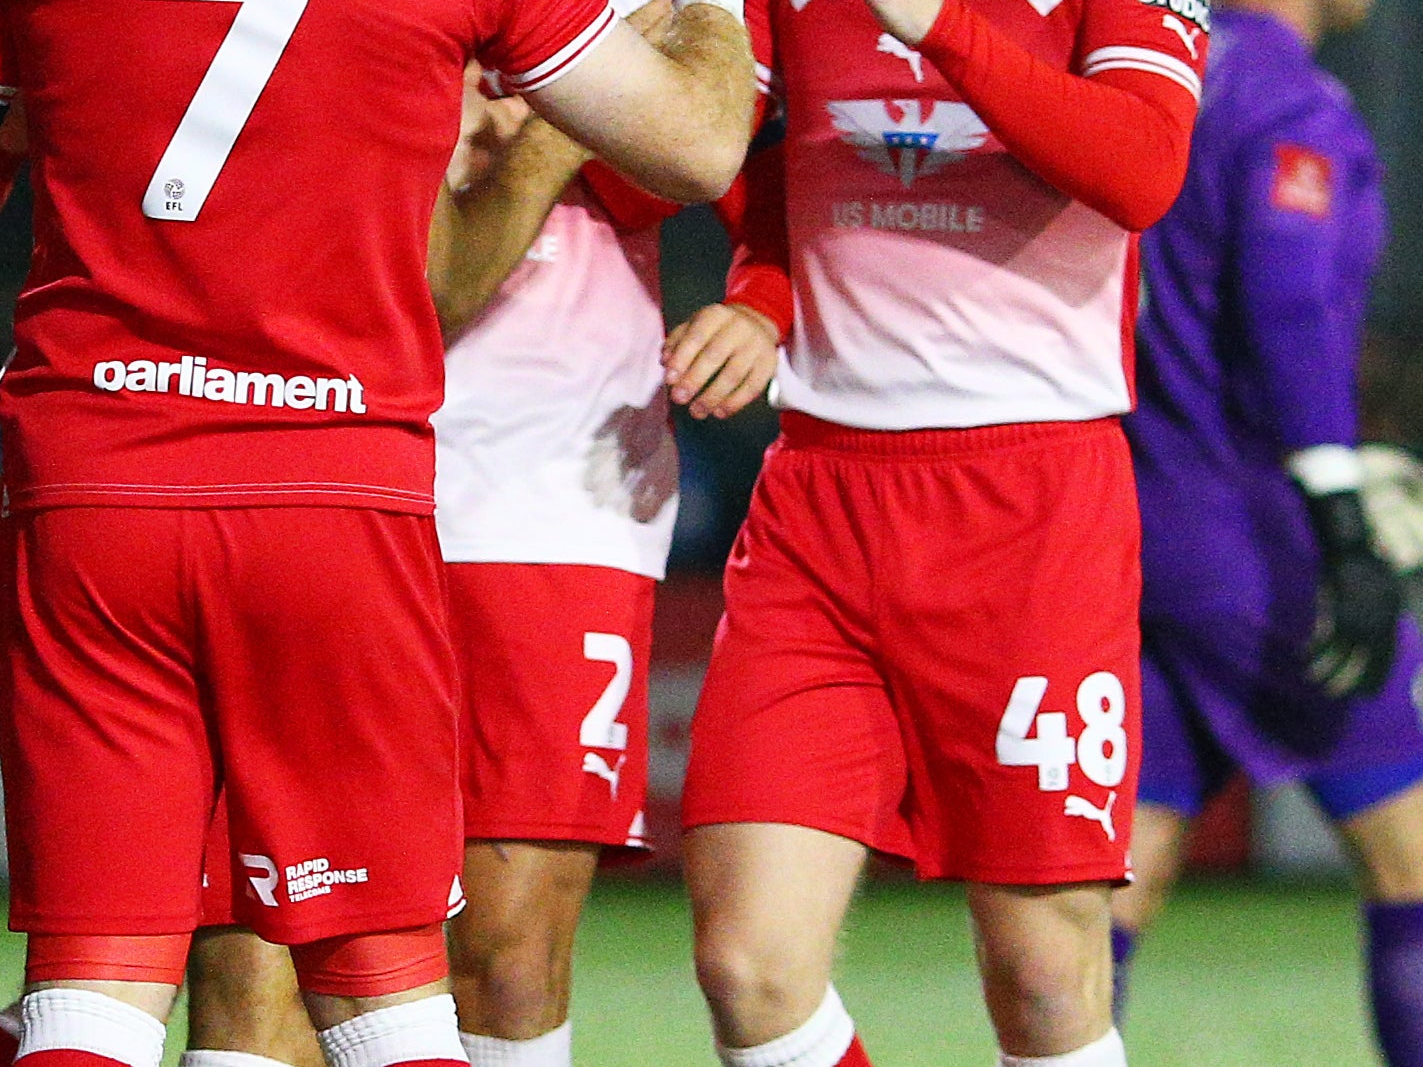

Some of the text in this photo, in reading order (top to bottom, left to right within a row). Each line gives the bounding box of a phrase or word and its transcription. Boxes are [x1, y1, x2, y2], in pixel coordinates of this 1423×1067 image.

[165, 200, 184, 212] EFL
[870, 202, 985, 233] MOBILE
[579, 631, 633, 750] 2
[995, 670, 1128, 793] 48
[285, 858, 330, 881] RAPID
[287, 868, 369, 895] RESPONSE
[289, 885, 332, 903] TELECOMS
